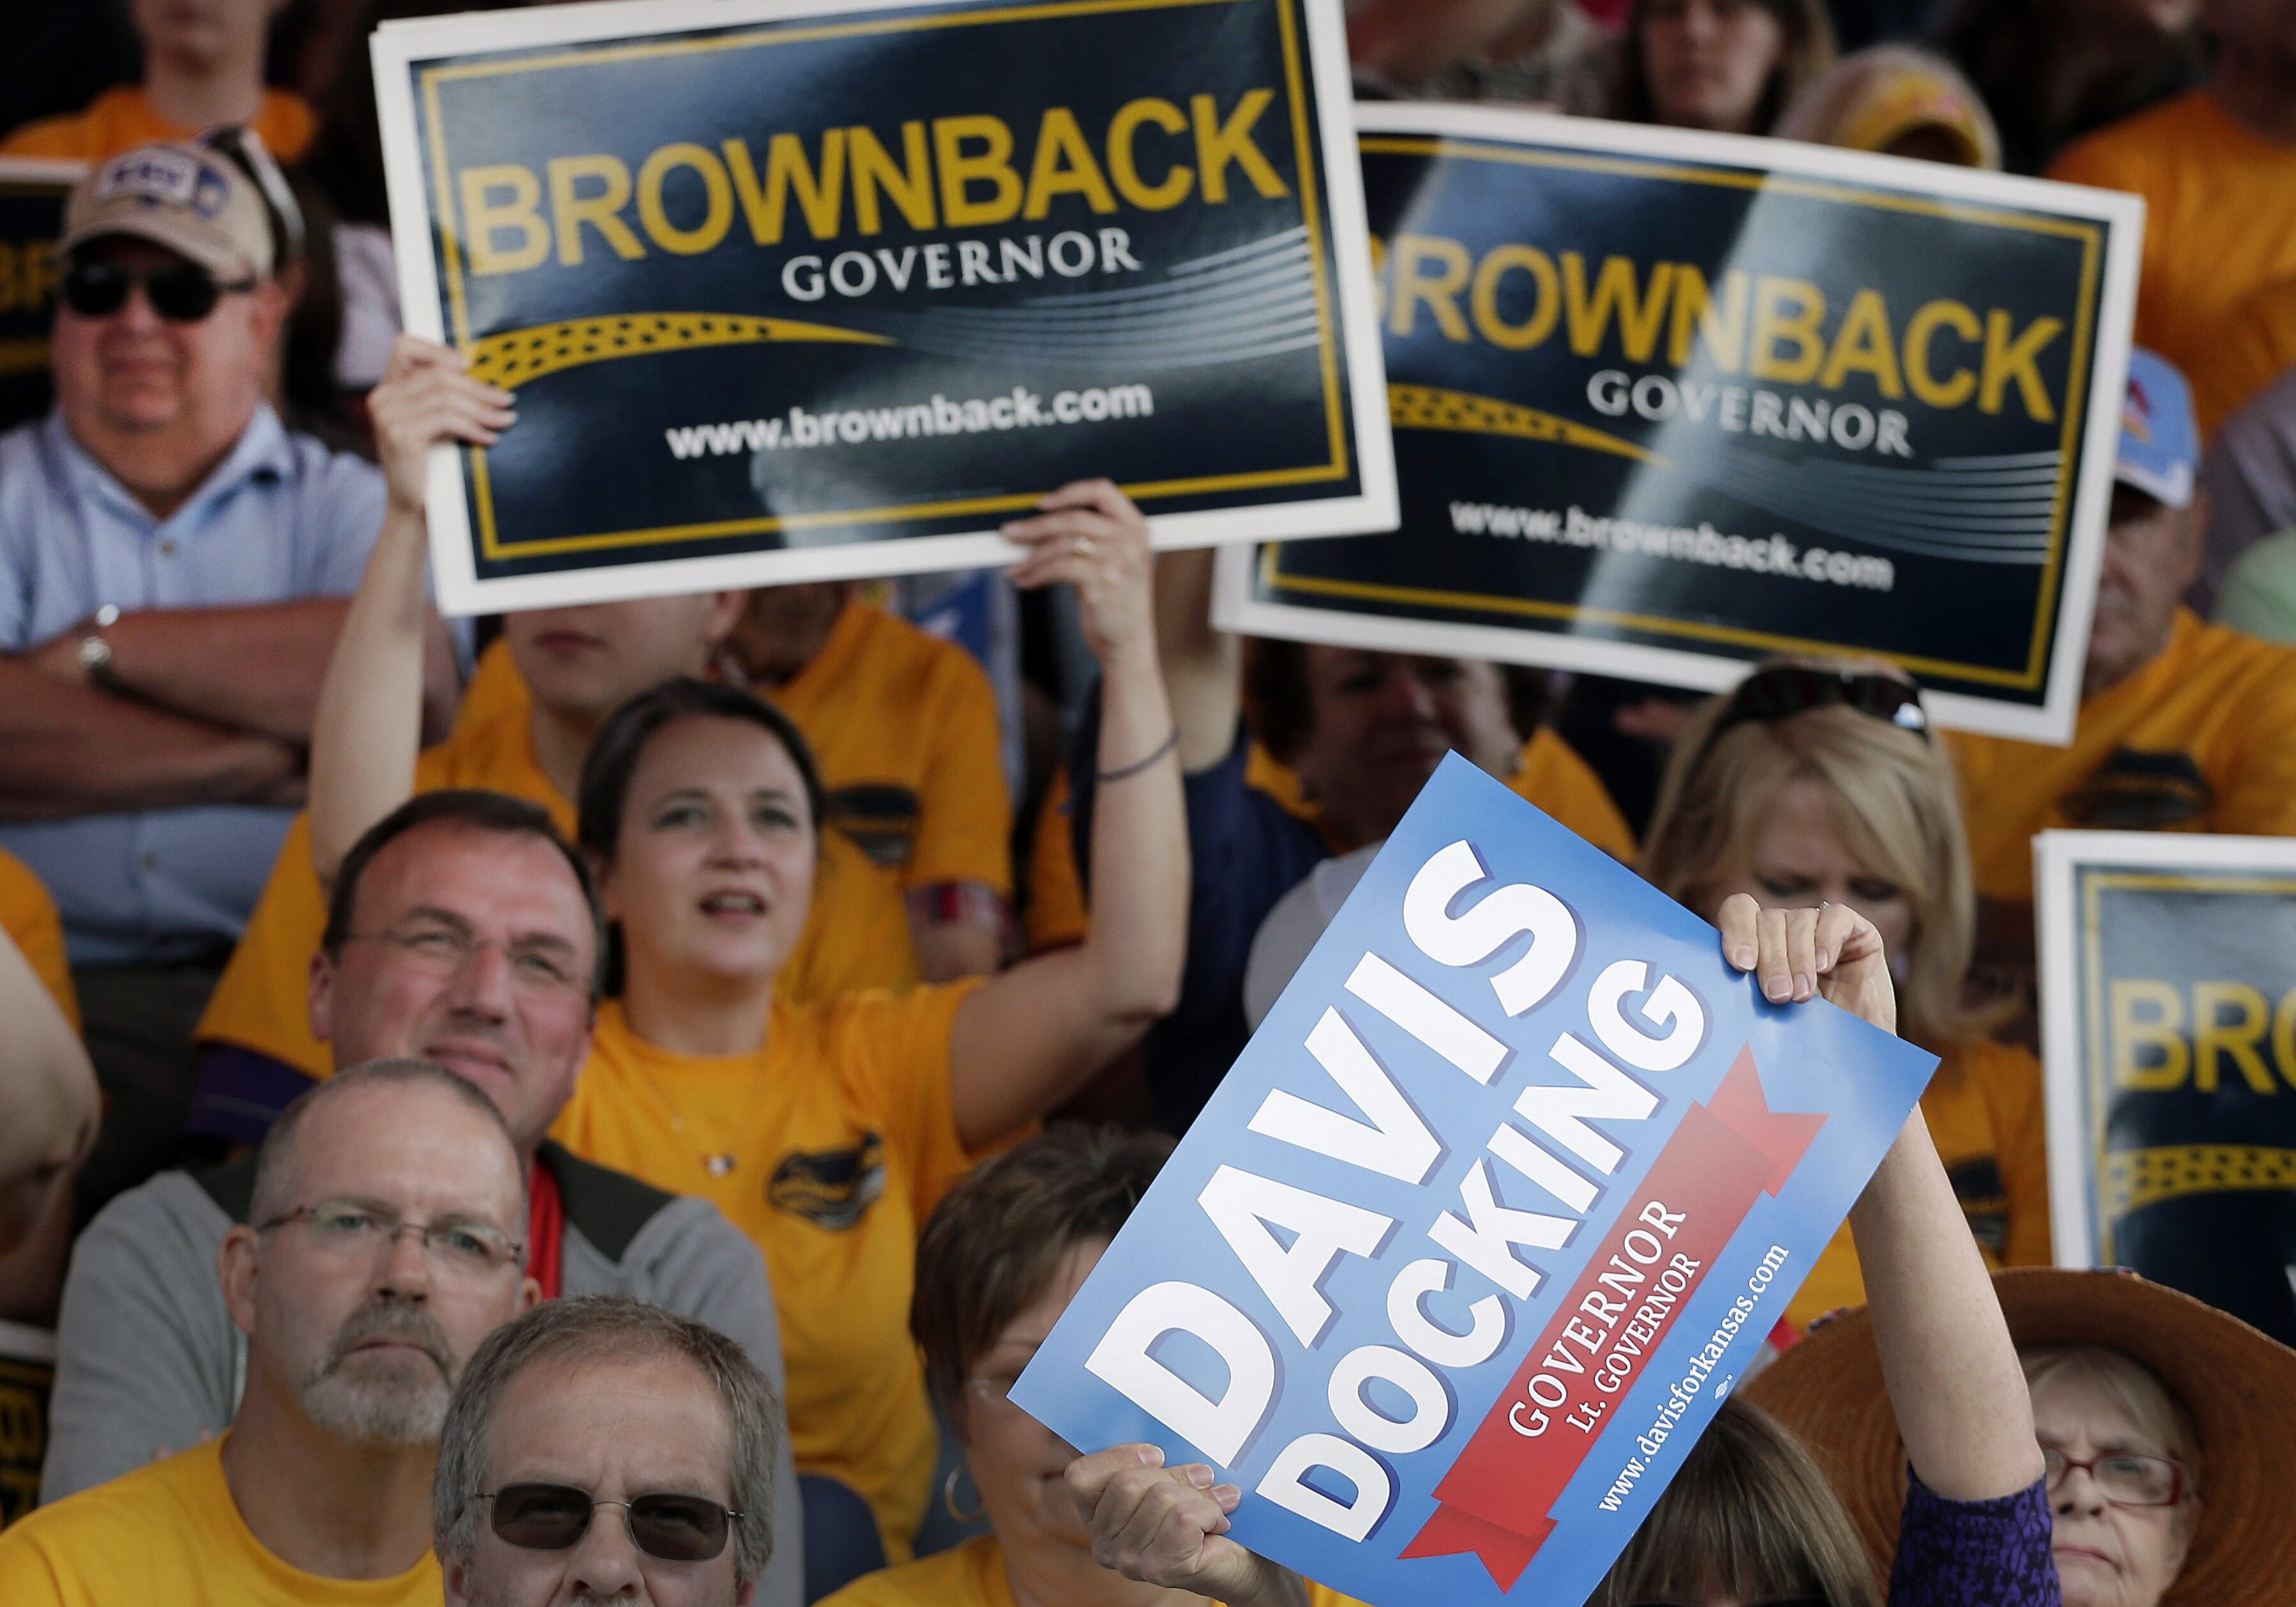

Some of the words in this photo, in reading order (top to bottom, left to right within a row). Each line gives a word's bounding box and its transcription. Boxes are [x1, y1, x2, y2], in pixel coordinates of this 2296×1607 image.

[460, 89, 1291, 277] BROWNBACK
[781, 227, 1144, 302] GOVERNOR
[665, 383, 1153, 460] www.brownback.com
[1370, 232, 2066, 423] ROWNBACK
[1587, 369, 1913, 458] GOVERNOR
[1450, 505, 1895, 592] www.brownback.com
[1084, 838, 1580, 1470] DAVIS
[1255, 959, 1708, 1544] DOCKING
[1508, 1200, 1687, 1439] GOVERNOR
[1565, 1401, 1608, 1434] Lt.
[1594, 1251, 1701, 1394] GOVERNOR
[1598, 1243, 1790, 1513] www.davisforkansas.com
